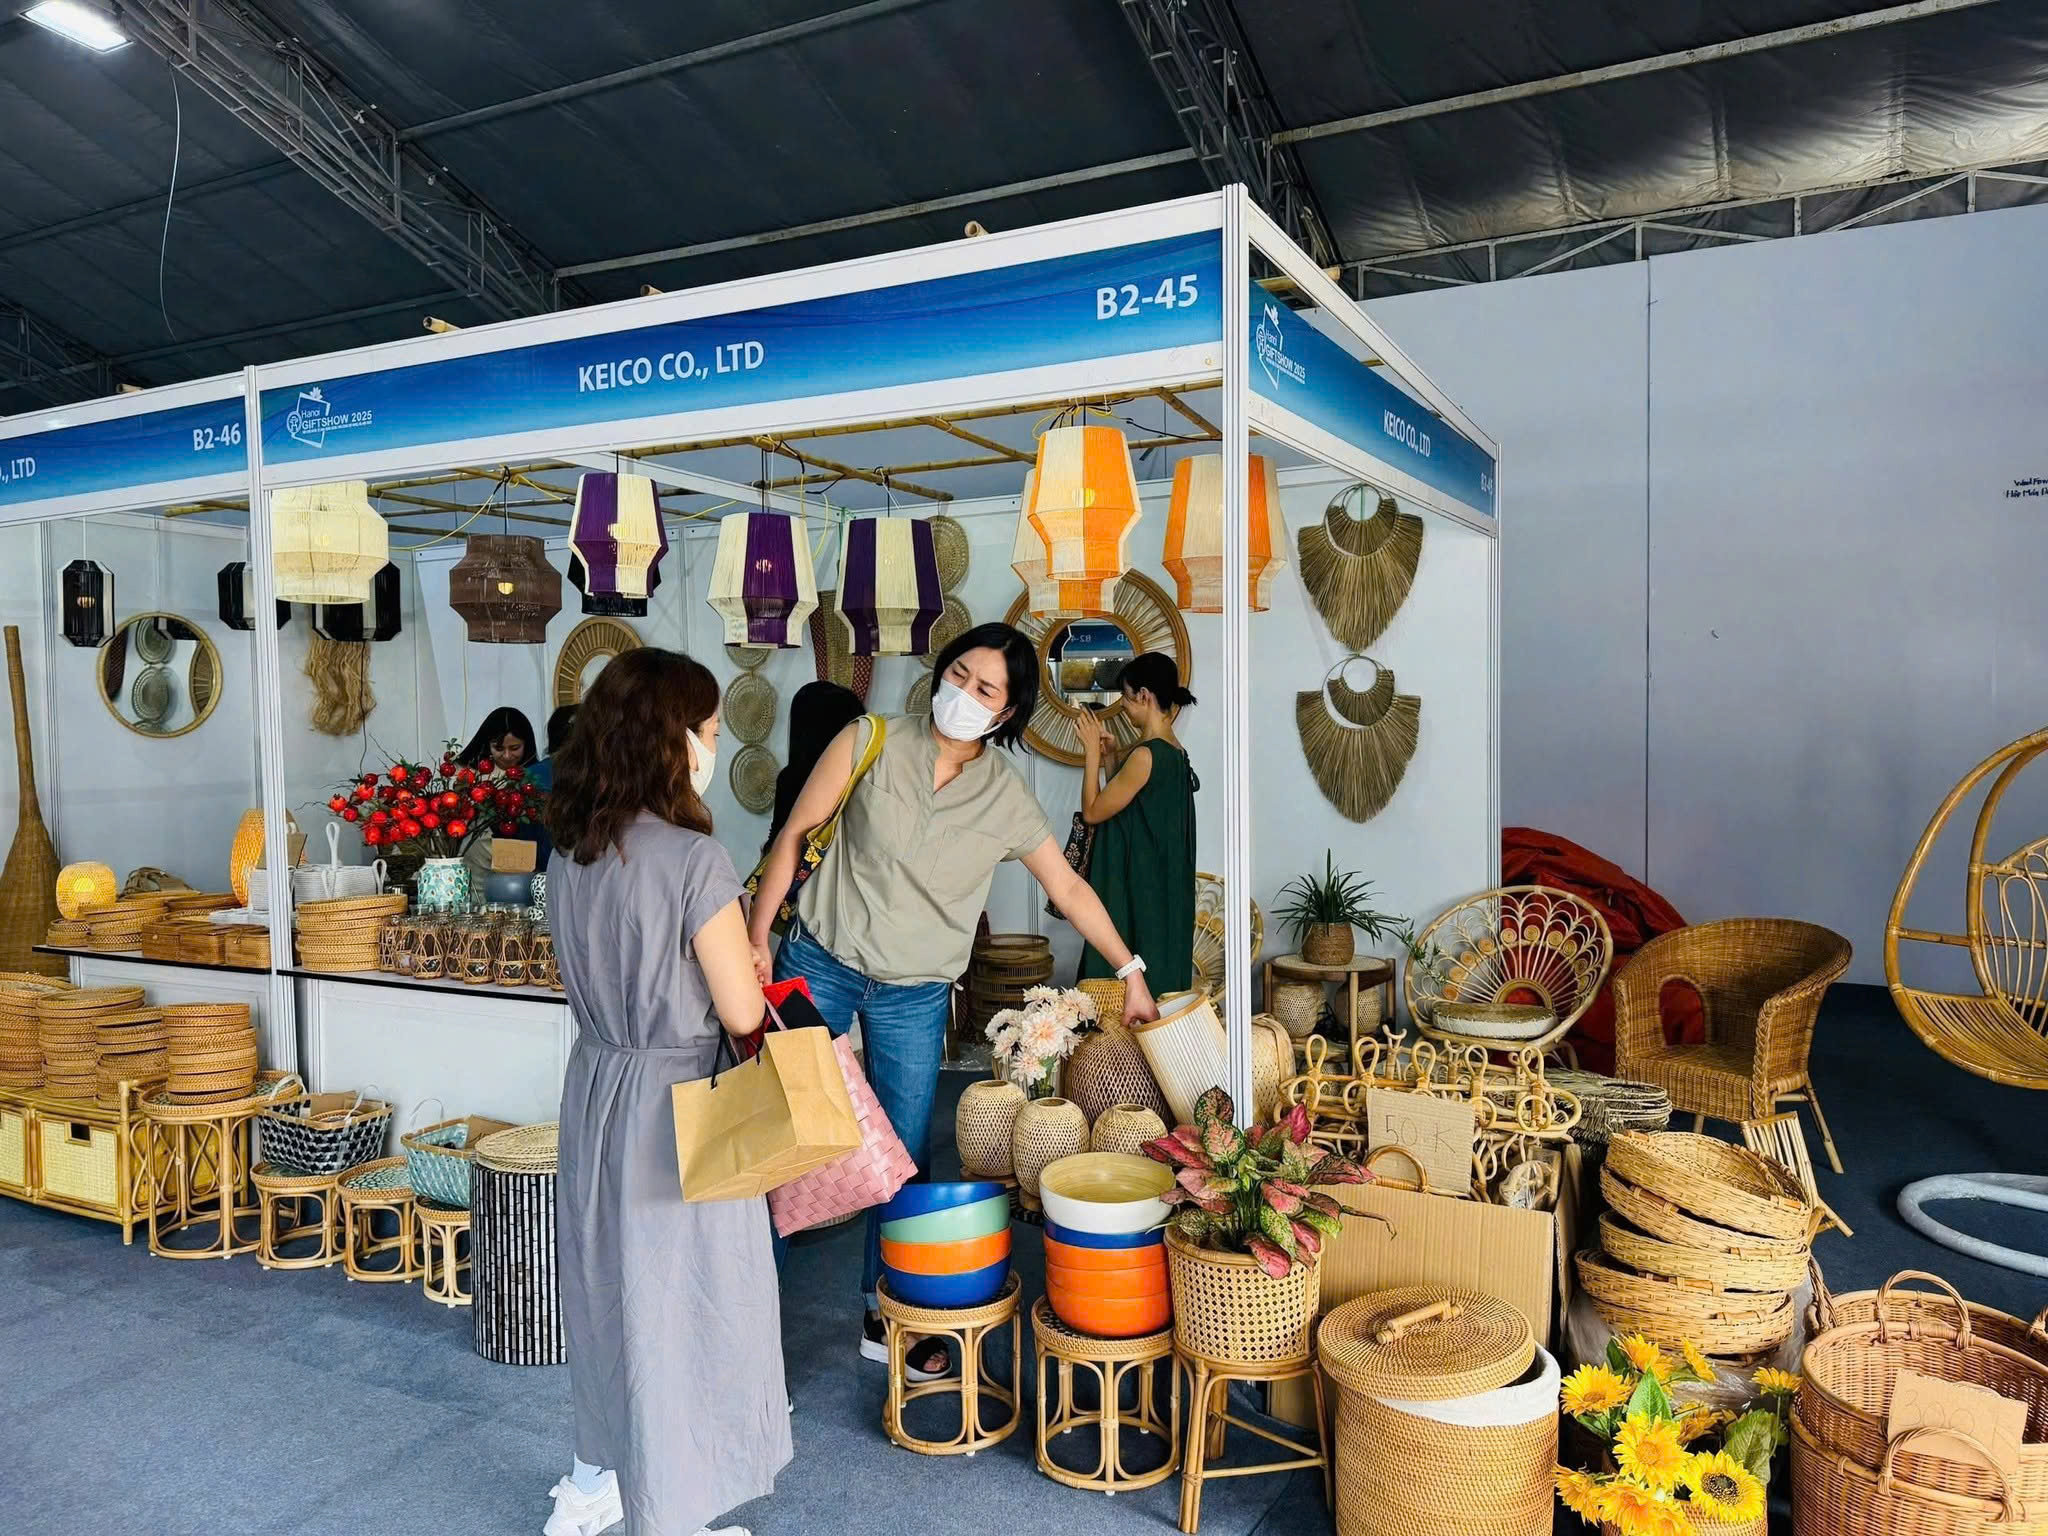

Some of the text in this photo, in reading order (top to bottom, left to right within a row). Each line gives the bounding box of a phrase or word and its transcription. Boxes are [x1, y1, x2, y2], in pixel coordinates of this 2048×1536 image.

[1096, 273, 1199, 320] B2-45
[578, 341, 765, 393] KEICO CO., LTD
[301, 409, 320, 418] Hanoi
[302, 414, 349, 430] GIFTSHOW
[351, 410, 373, 422] 2025
[193, 422, 242, 452] B2-46
[1383, 409, 1406, 443] KEICO
[1419, 431, 1431, 458] LTD
[11, 456, 36, 480] LTD
